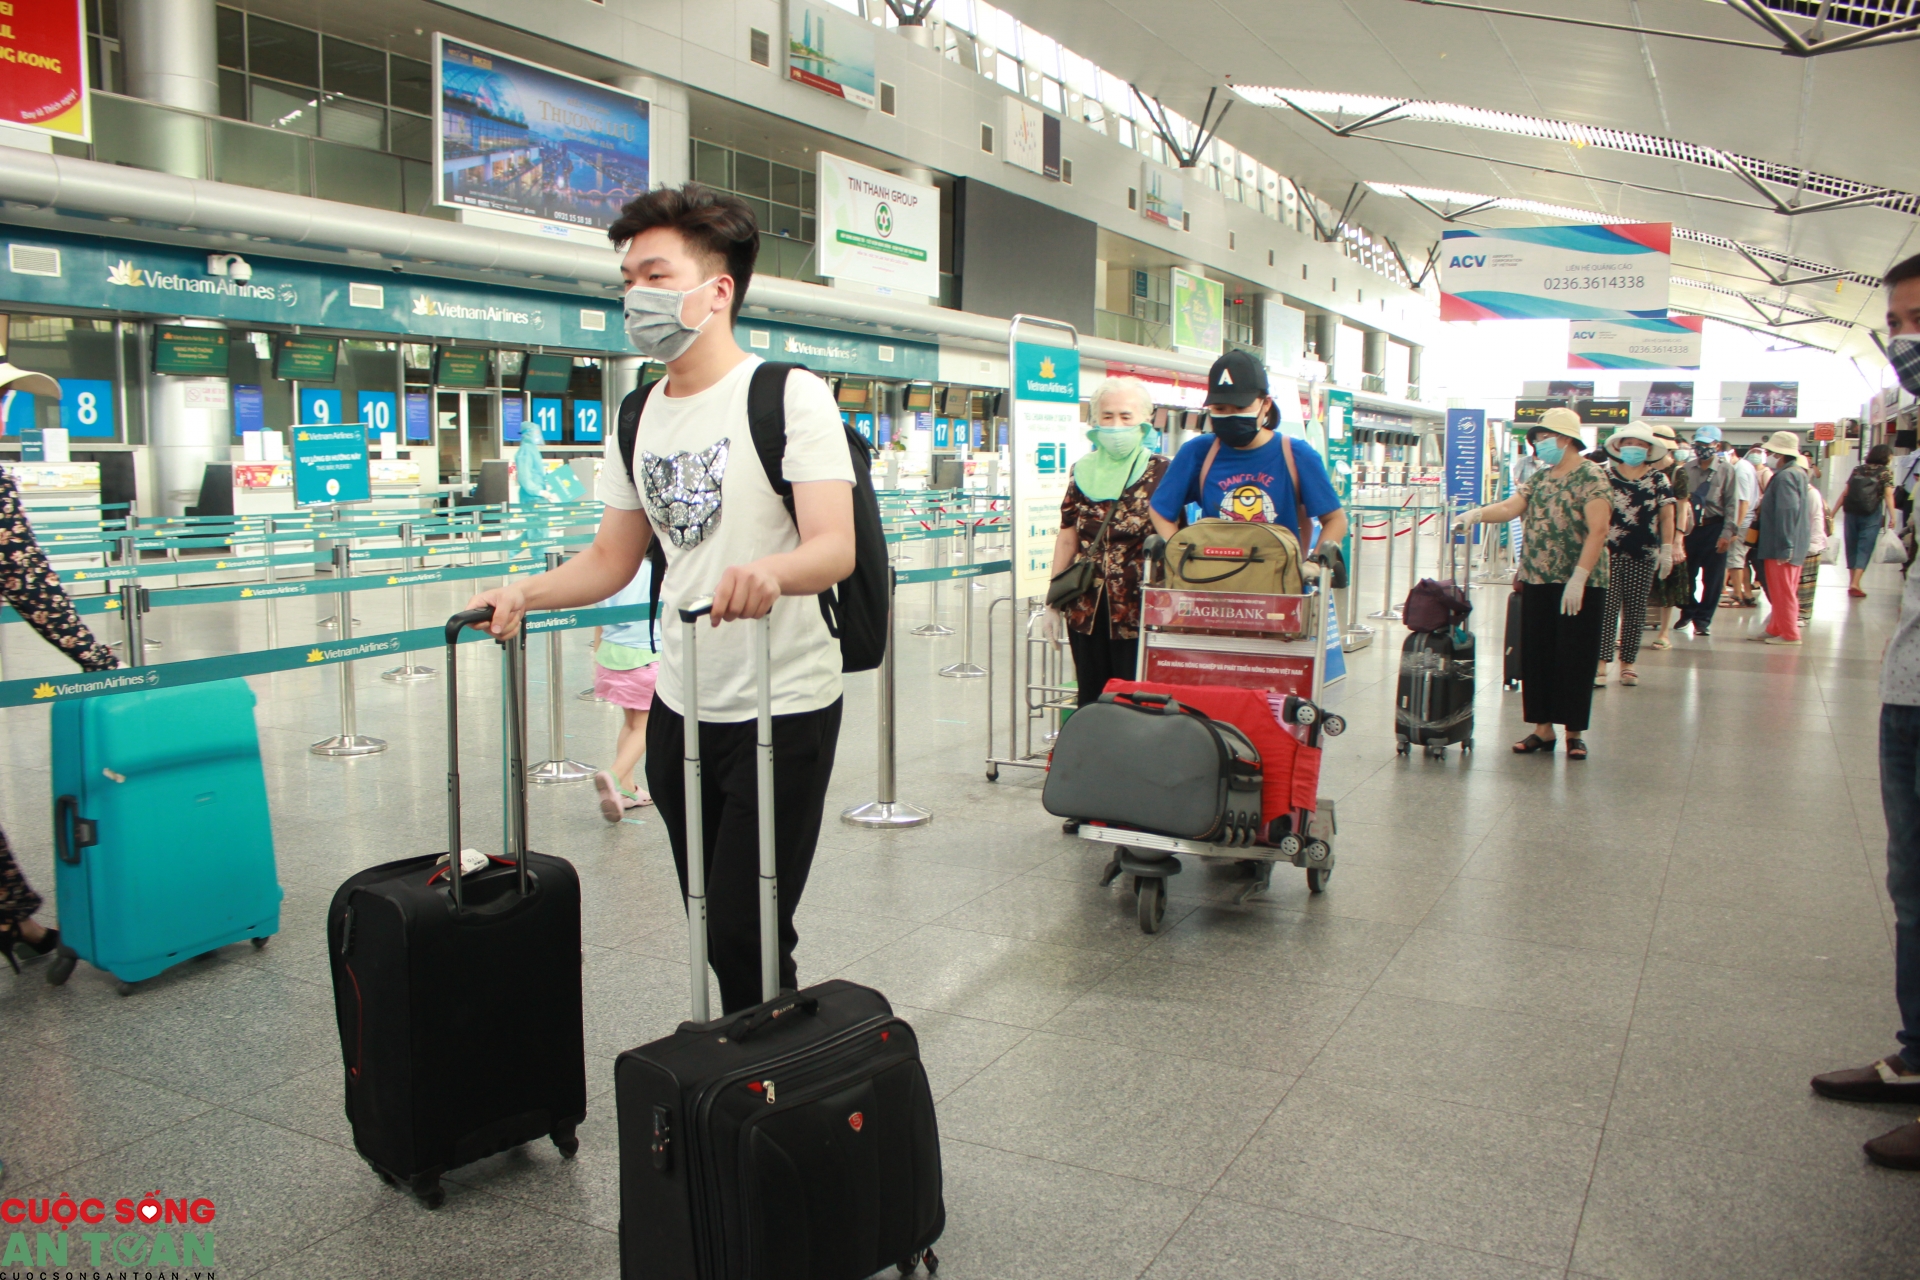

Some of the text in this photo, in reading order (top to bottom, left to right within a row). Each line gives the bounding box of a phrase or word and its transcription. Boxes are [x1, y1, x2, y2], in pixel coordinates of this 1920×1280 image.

[17, 50, 61, 74] KONG
[848, 177, 918, 207] TIN THANH GROUP
[554, 211, 592, 226] 0931 15 18 18
[1449, 255, 1487, 268] ACV
[1617, 263, 1633, 271] CÁO
[1543, 276, 1645, 290] 0236.3614338
[1573, 331, 1595, 339] ACV
[1629, 345, 1689, 353] 0236.3614338
[1218, 368, 1234, 385] A
[77, 391, 98, 425] 8
[313, 398, 330, 425] 9
[363, 401, 389, 429] 10
[537, 406, 556, 432] 11
[577, 408, 598, 432] 12
[858, 419, 871, 439] 16
[936, 424, 947, 441] 17
[955, 425, 966, 442] 18
[1192, 606, 1265, 619] AGRIBANK
[1224, 663, 1236, 671] PHÁT
[1280, 667, 1291, 676] VIỆT
